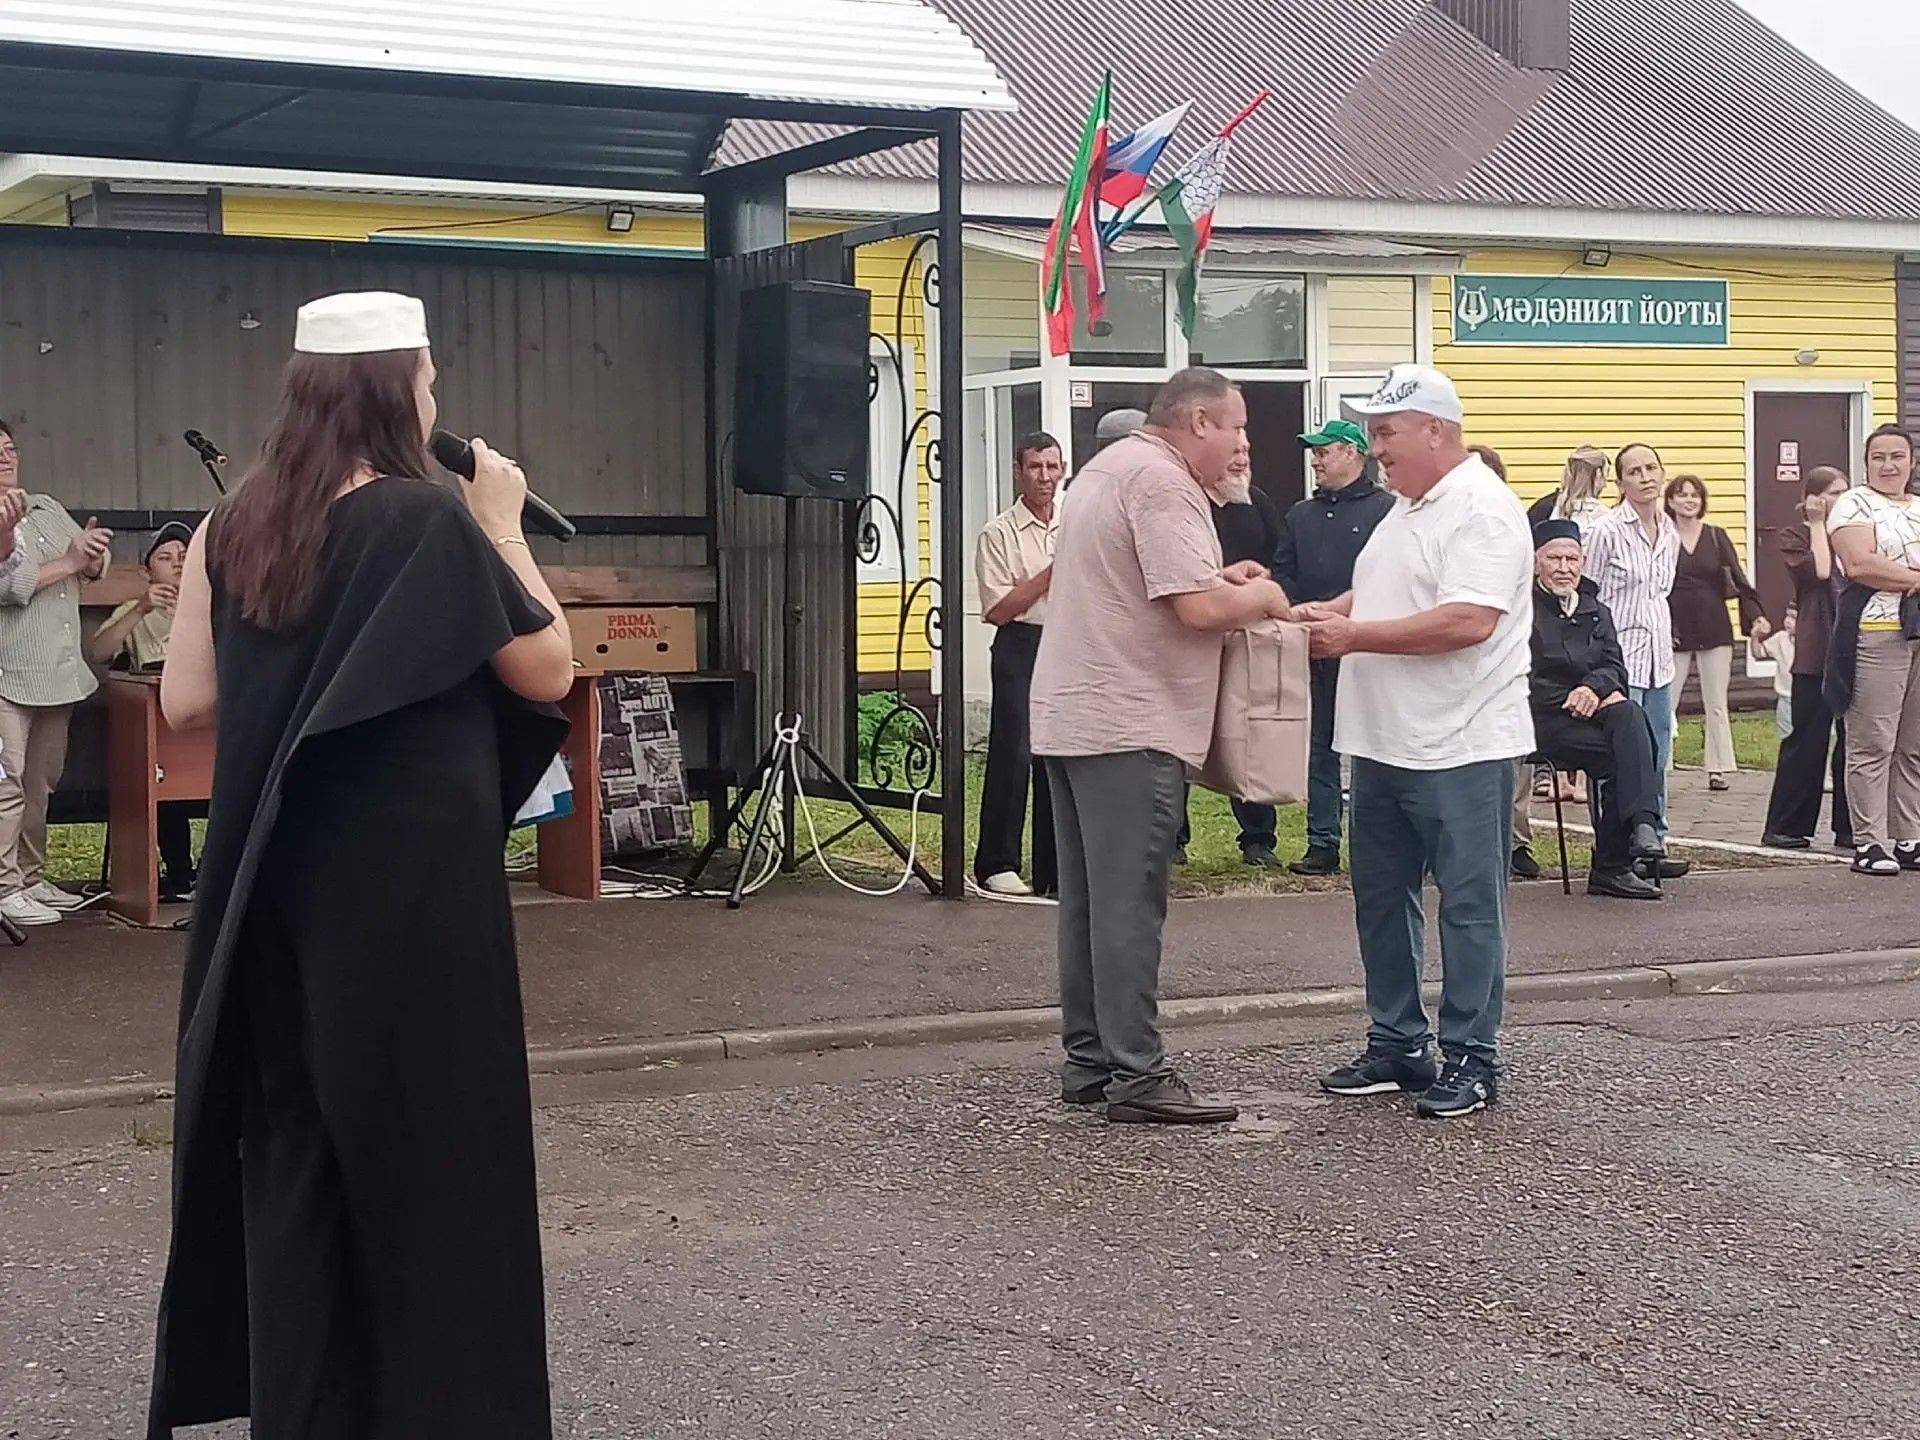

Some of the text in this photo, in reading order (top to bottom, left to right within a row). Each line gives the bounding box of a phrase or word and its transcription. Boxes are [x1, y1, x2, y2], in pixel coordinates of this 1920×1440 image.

[1492, 294, 1723, 328] МӘДӘНИЯТ ЙОРТЫ
[607, 614, 656, 626] PRIMA
[607, 627, 658, 640] DONNA
